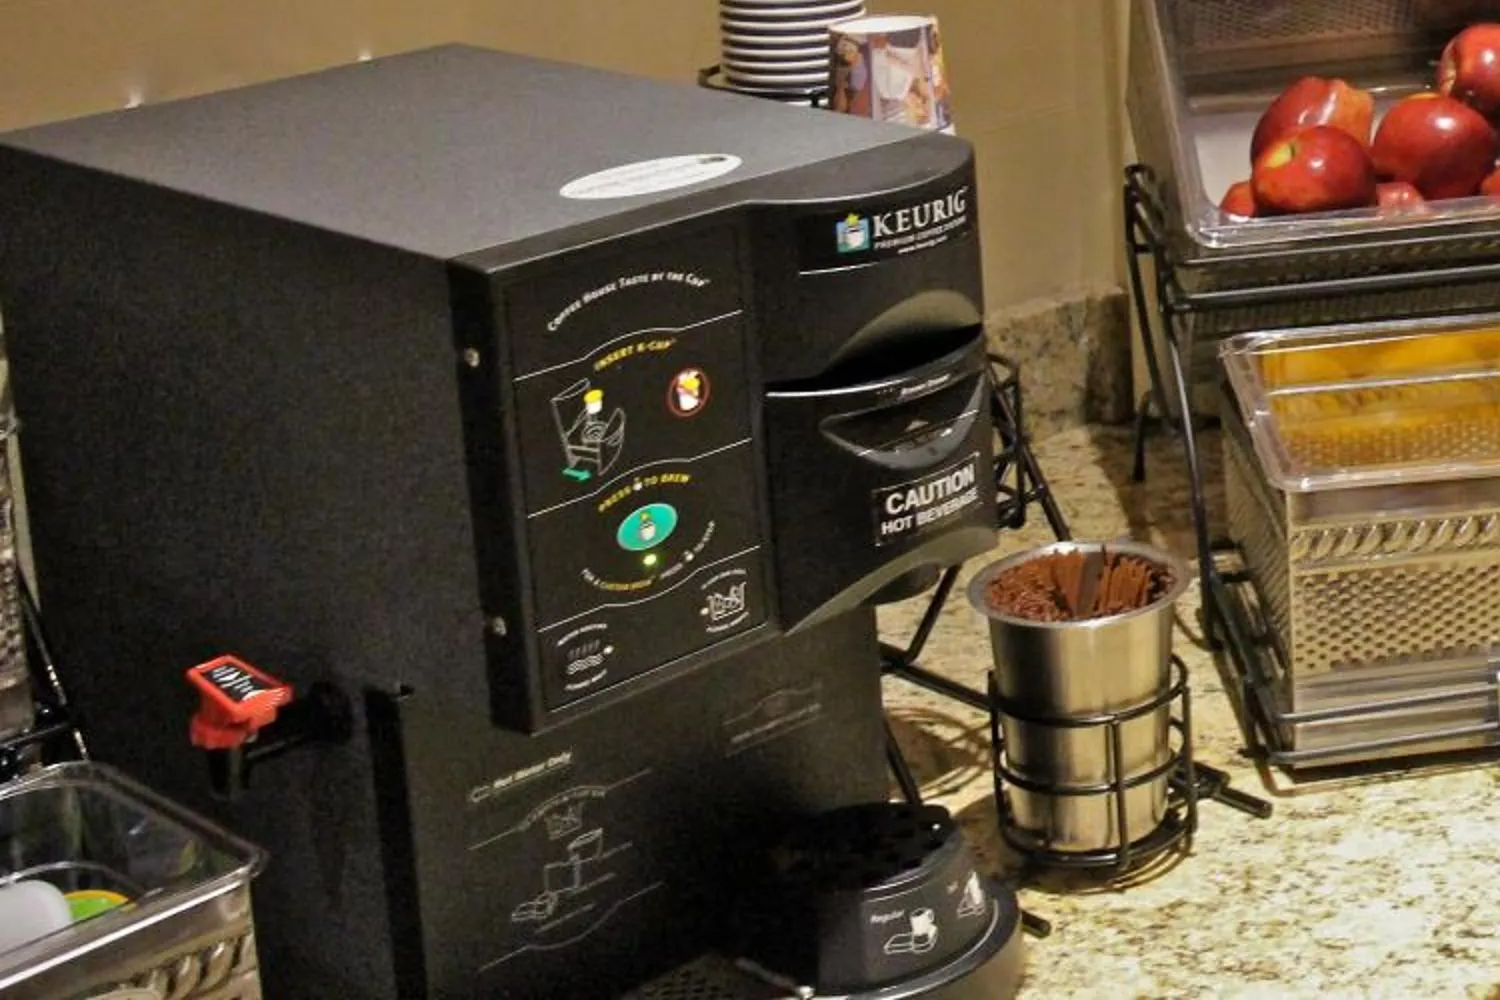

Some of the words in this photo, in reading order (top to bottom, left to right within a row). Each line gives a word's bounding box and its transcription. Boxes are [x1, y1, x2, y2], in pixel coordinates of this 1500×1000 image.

[873, 187, 968, 237] KEURIG
[885, 463, 976, 515] CAUTION
[880, 516, 913, 536] HOT
